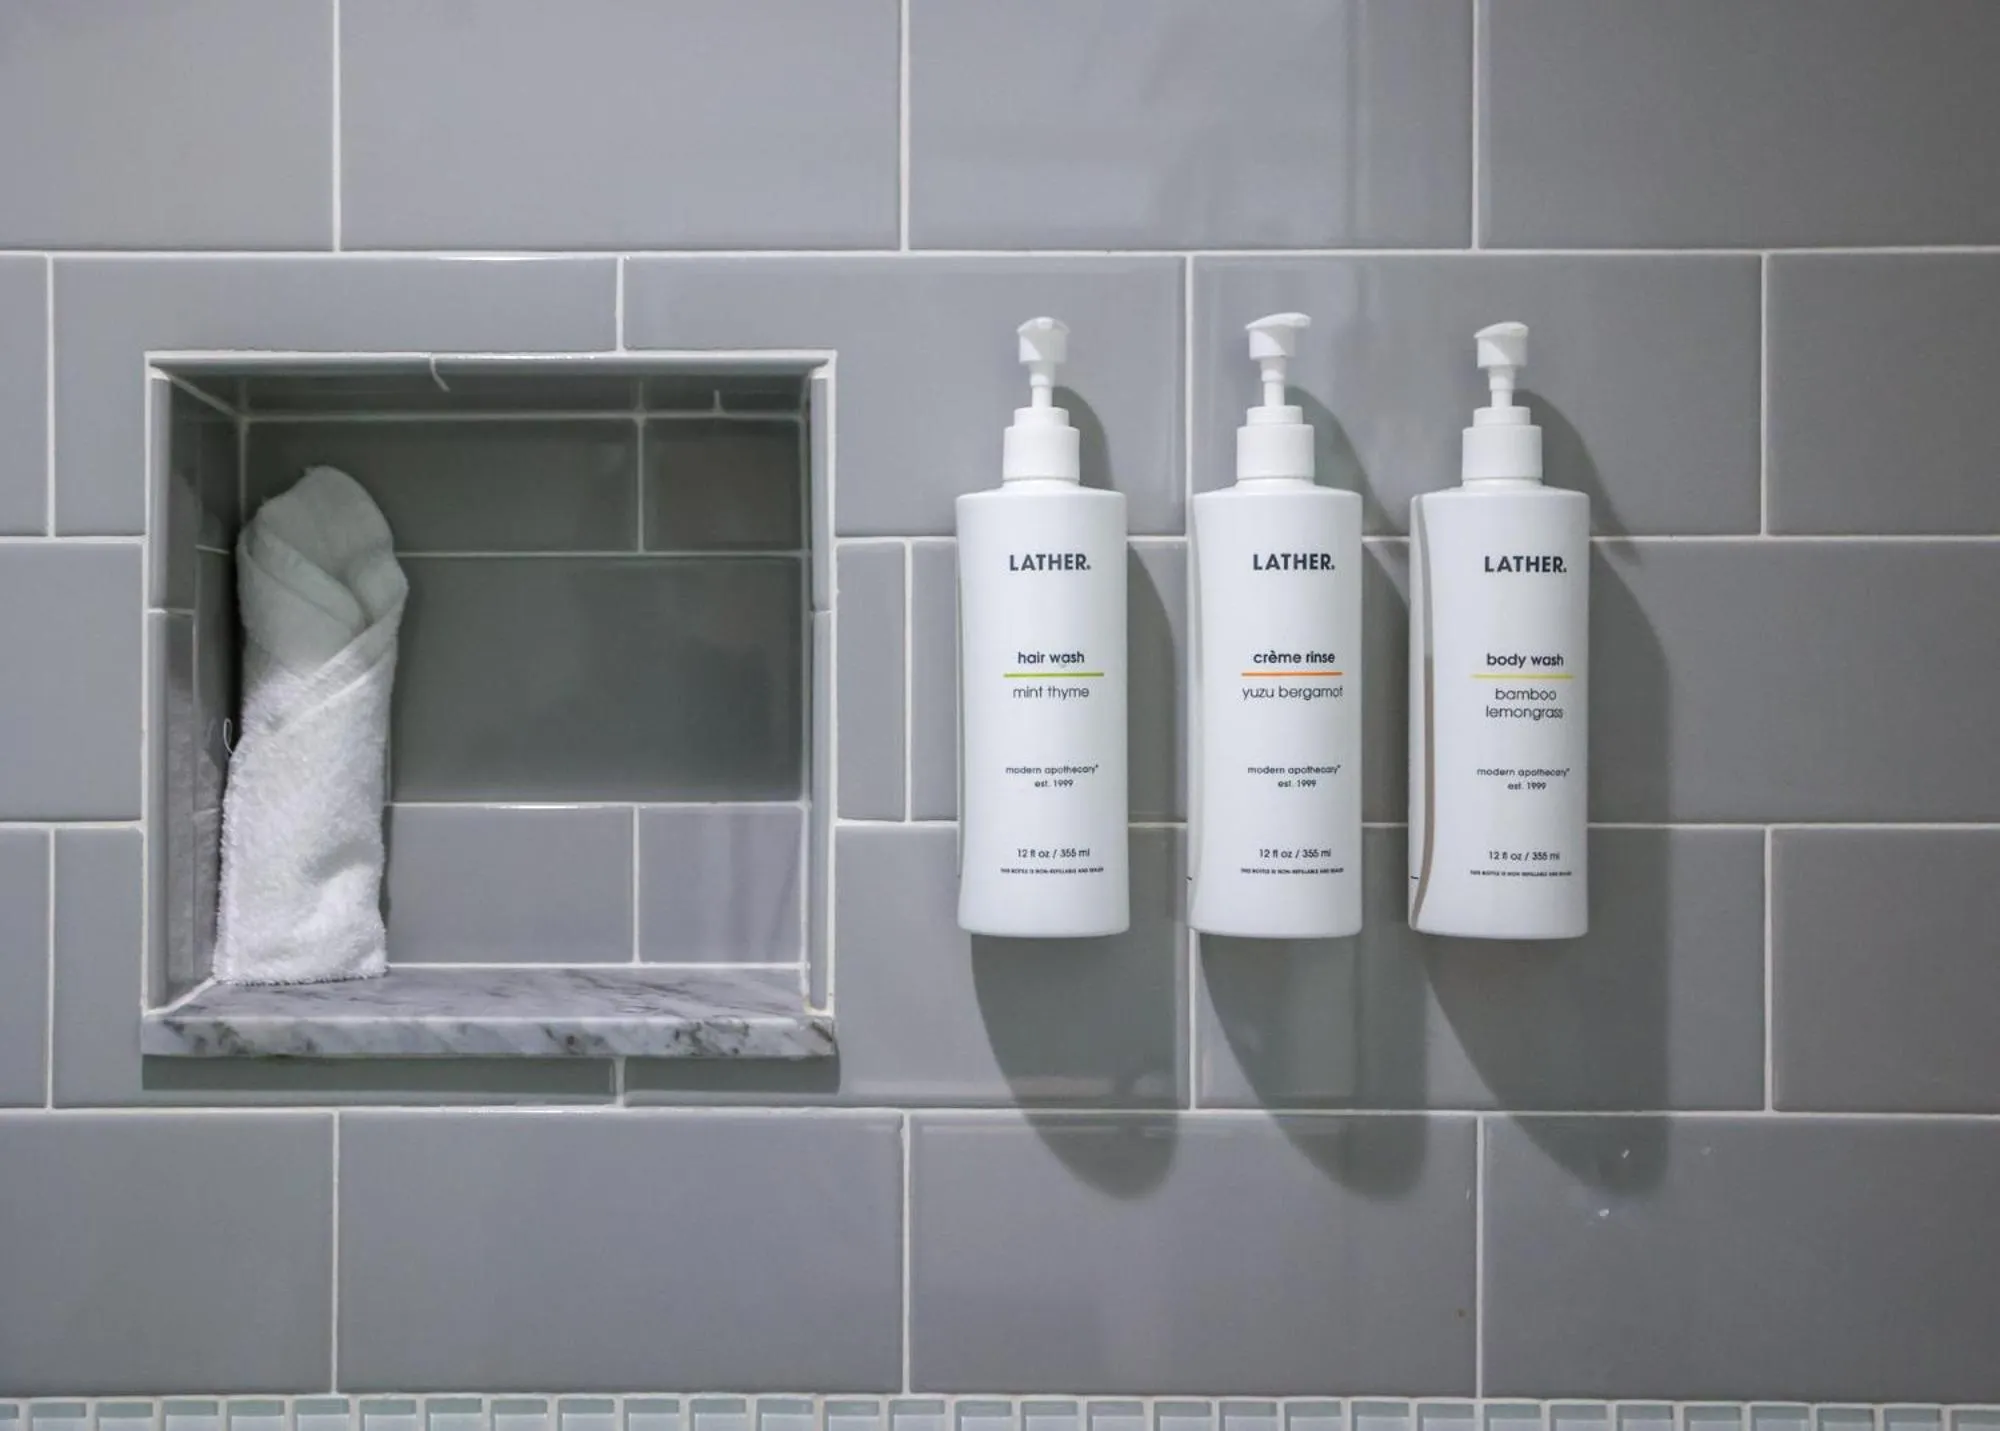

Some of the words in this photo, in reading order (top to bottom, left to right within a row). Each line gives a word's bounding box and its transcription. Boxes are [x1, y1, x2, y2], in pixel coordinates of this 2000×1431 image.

[1009, 553, 1091, 571] LATHER.
[1253, 553, 1335, 570] LATHER.
[1485, 556, 1566, 573] LATHER.
[1018, 652, 1045, 664] hair
[1049, 651, 1084, 663] wash
[1253, 651, 1301, 663] crème
[1305, 651, 1335, 663] rinse
[1487, 653, 1526, 668] body
[1531, 655, 1564, 666] wash
[1013, 687, 1042, 698] mint
[1048, 686, 1089, 699] thyme
[1242, 688, 1274, 699] yuzu
[1279, 686, 1343, 700] bergamot
[1496, 688, 1556, 700] bamboo
[1486, 706, 1563, 720] lemongrass
[1006, 766, 1041, 774] modern
[1248, 766, 1284, 774] modern
[1477, 768, 1515, 776] modern
[1034, 779, 1050, 787] est.
[1054, 779, 1073, 787] 1999
[1298, 779, 1316, 787] 1999
[1507, 782, 1524, 790] est.
[1527, 782, 1546, 790] 1999
[1017, 849, 1027, 858] 12
[1038, 850, 1049, 858] oz
[1052, 849, 1057, 858] /
[1060, 849, 1076, 857] 355
[1079, 848, 1089, 857] ml
[1259, 849, 1270, 858] 12
[1273, 849, 1278, 858] fl
[1281, 850, 1292, 858] oz
[1295, 849, 1300, 858] /
[1302, 849, 1319, 857] 355
[1321, 848, 1331, 857] ml
[1489, 851, 1500, 860] 12
[1511, 852, 1522, 860] oz
[1524, 852, 1529, 861] /
[1550, 851, 1560, 860] ml
